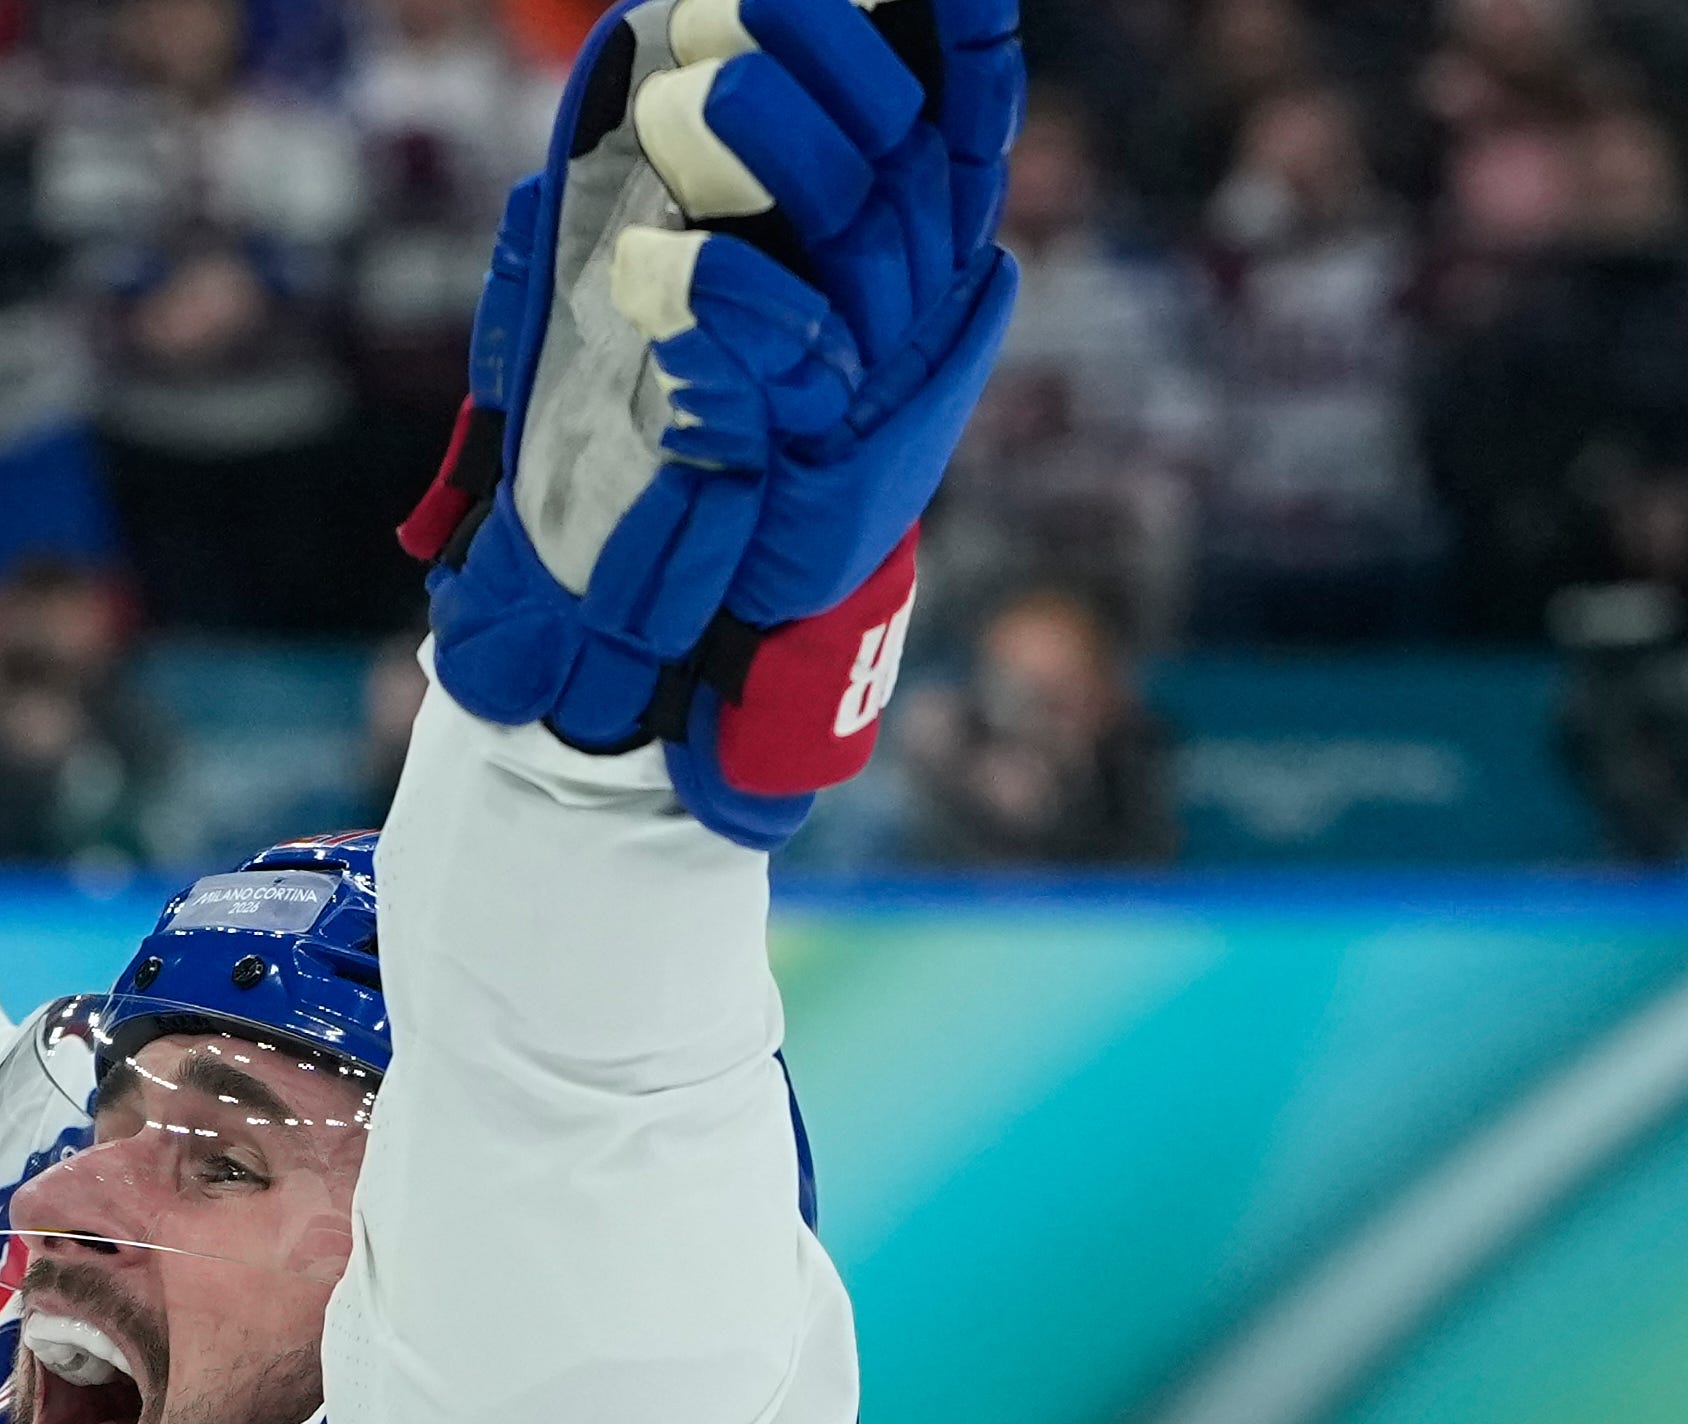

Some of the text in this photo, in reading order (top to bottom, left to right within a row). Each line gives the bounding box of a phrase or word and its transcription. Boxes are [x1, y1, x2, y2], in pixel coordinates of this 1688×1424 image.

[192, 887, 318, 906] MILANO CORTINA
[228, 901, 261, 915] 2026
